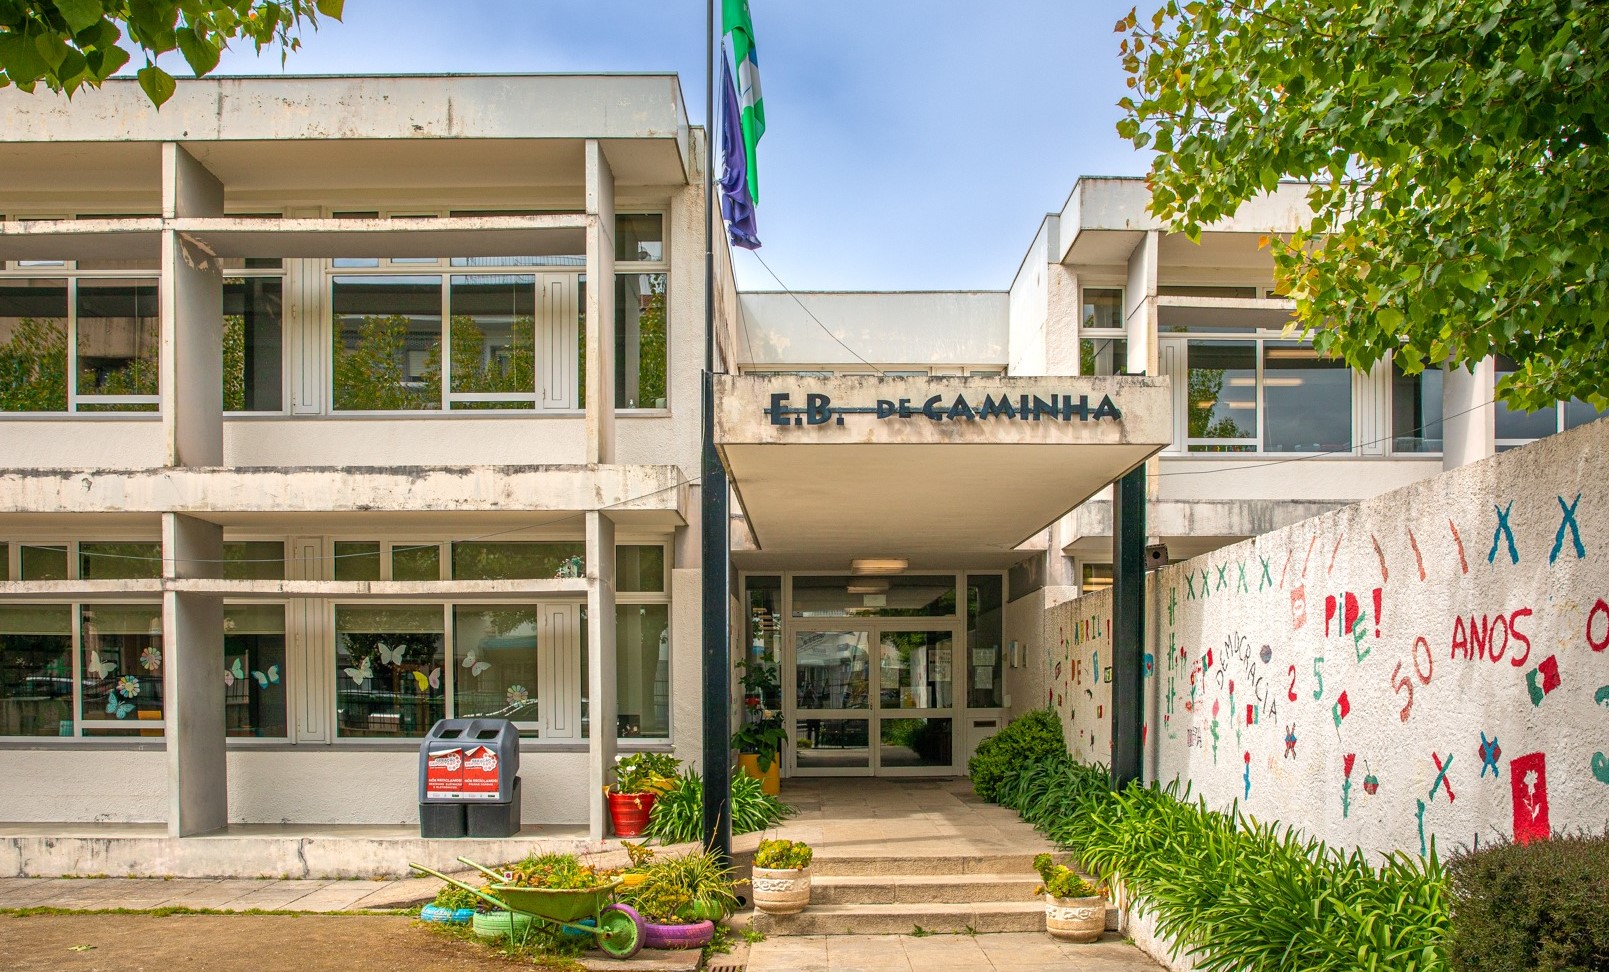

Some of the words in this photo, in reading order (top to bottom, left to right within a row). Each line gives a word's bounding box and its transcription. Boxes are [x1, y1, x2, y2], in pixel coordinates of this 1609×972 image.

[770, 392, 845, 426] E.B.
[876, 397, 911, 420] DE
[922, 393, 1123, 422] CAMINHA
[1071, 658, 1082, 686] DE
[1215, 631, 1278, 724] DEMOCRACIA
[1287, 656, 1325, 702] 25
[1391, 635, 1434, 723] 50
[1451, 606, 1534, 668] ANOS
